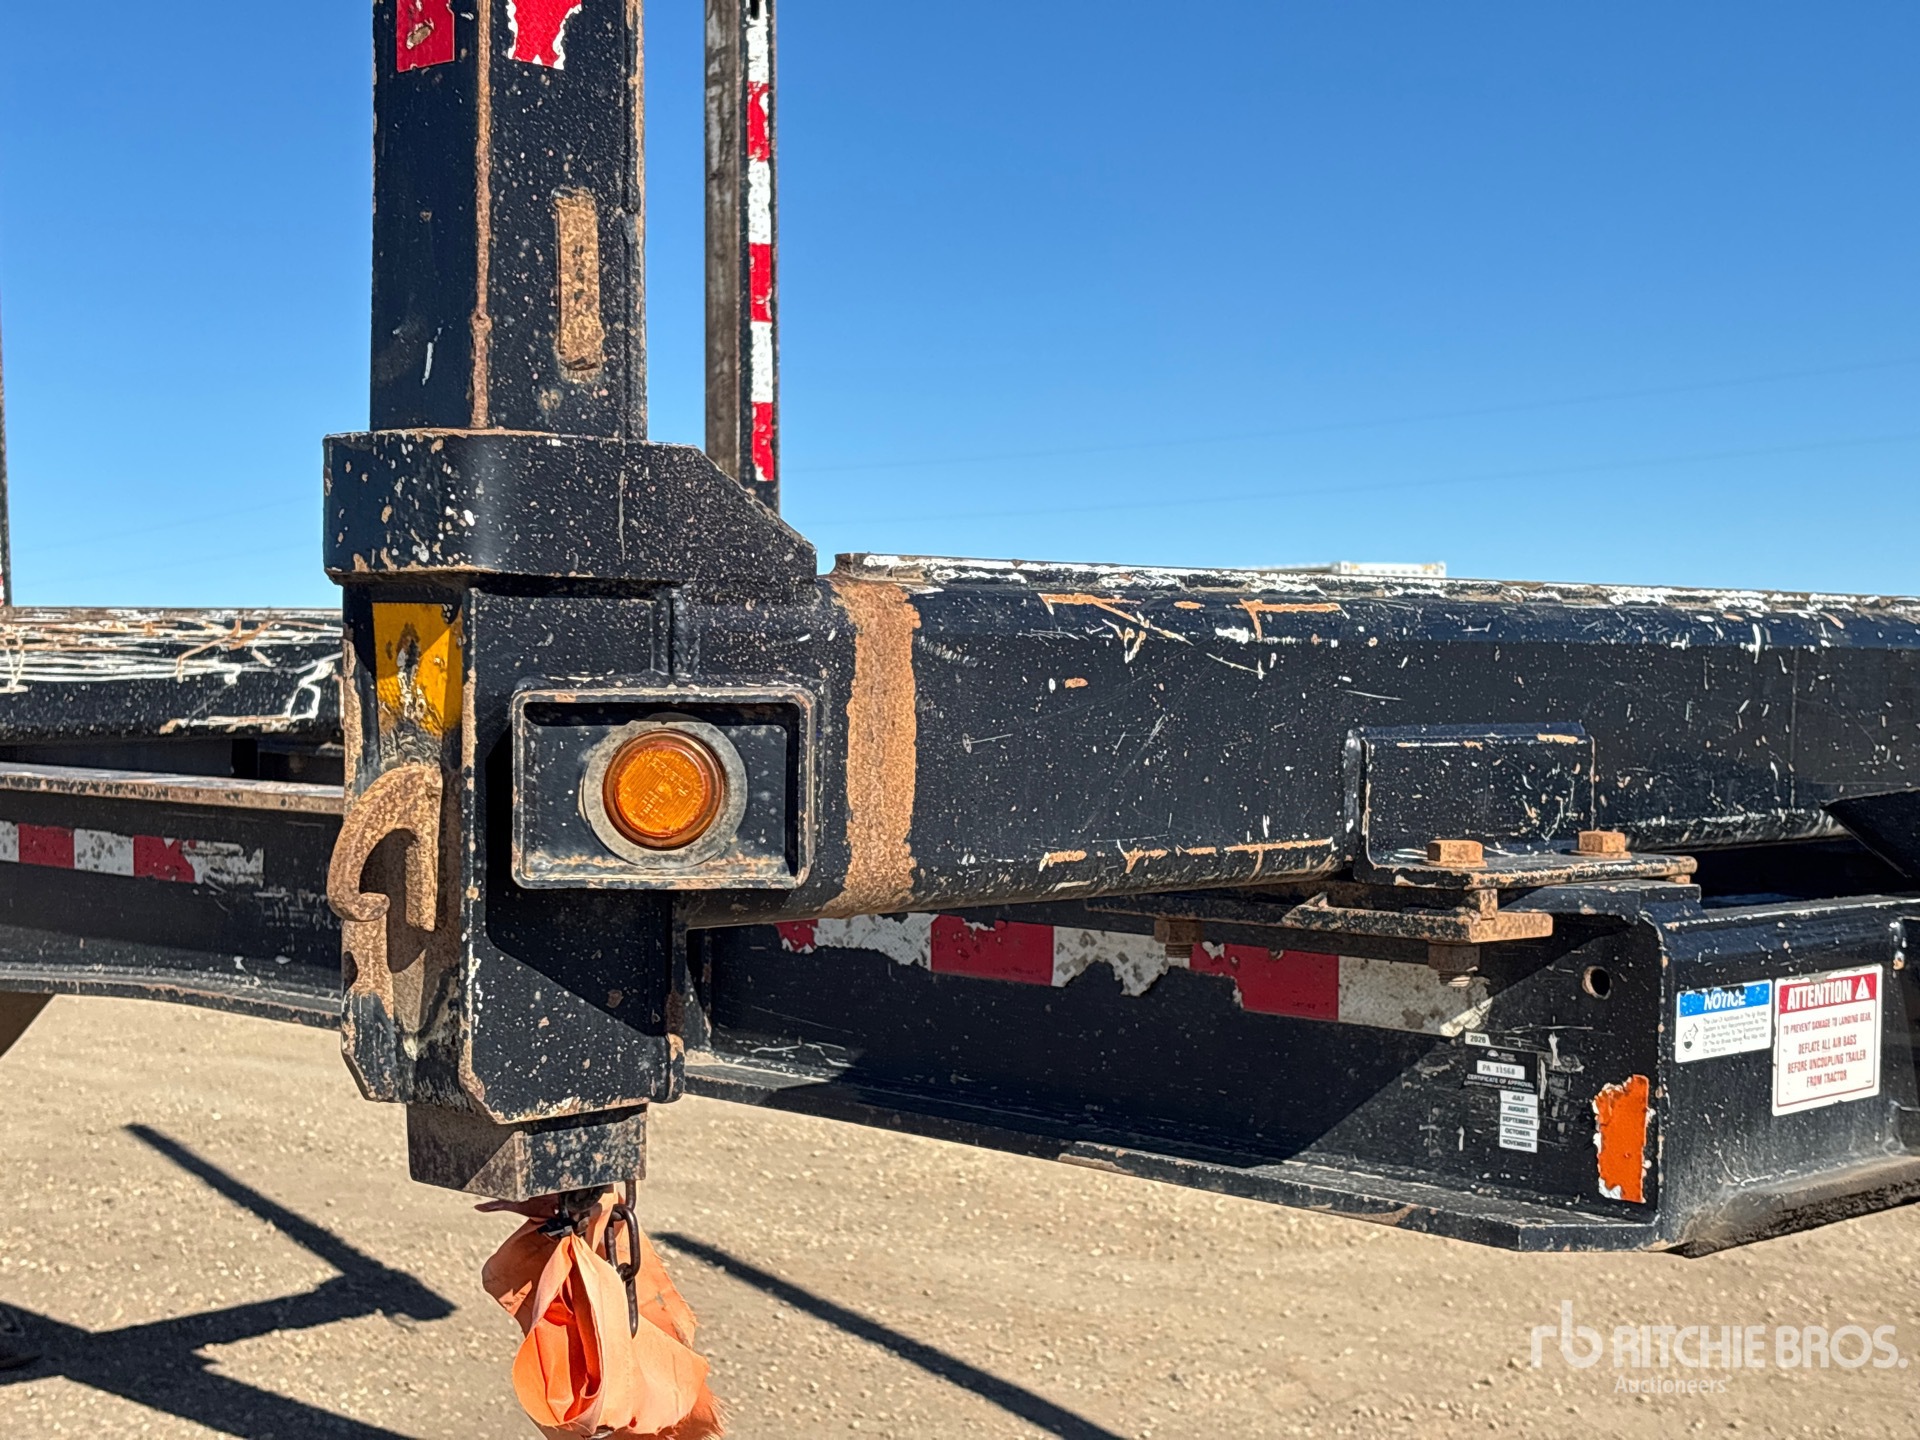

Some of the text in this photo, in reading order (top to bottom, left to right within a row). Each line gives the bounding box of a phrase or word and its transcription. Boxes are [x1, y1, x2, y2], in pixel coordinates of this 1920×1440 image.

[1704, 990, 1747, 1011] NOTICE
[1787, 979, 1852, 1011] ATTENTION
[1783, 1025, 1789, 1036] TO
[1790, 1021, 1811, 1034] PREVENT
[1812, 1018, 1830, 1031] DAMAGE
[1832, 1016, 1838, 1027] TO
[1839, 1013, 1859, 1026] LANDING
[1798, 1034, 1857, 1055] DEFLATE ALL AIR BAGS
[1482, 1064, 1491, 1072] PA
[1787, 1049, 1867, 1074] BEFORE UNCOUPLING TRAILER
[1466, 1073, 1499, 1084] CERTIFICATE
[1507, 1080, 1535, 1089] APPROVAL
[1806, 1069, 1847, 1088] FROM TRACTOR
[1512, 1094, 1525, 1102] JULY
[1507, 1105, 1529, 1114] AUGUST
[1502, 1116, 1534, 1126] SEPTEMBER
[1504, 1127, 1531, 1137] OCTOBER
[1502, 1138, 1532, 1148] NOVEMBER
